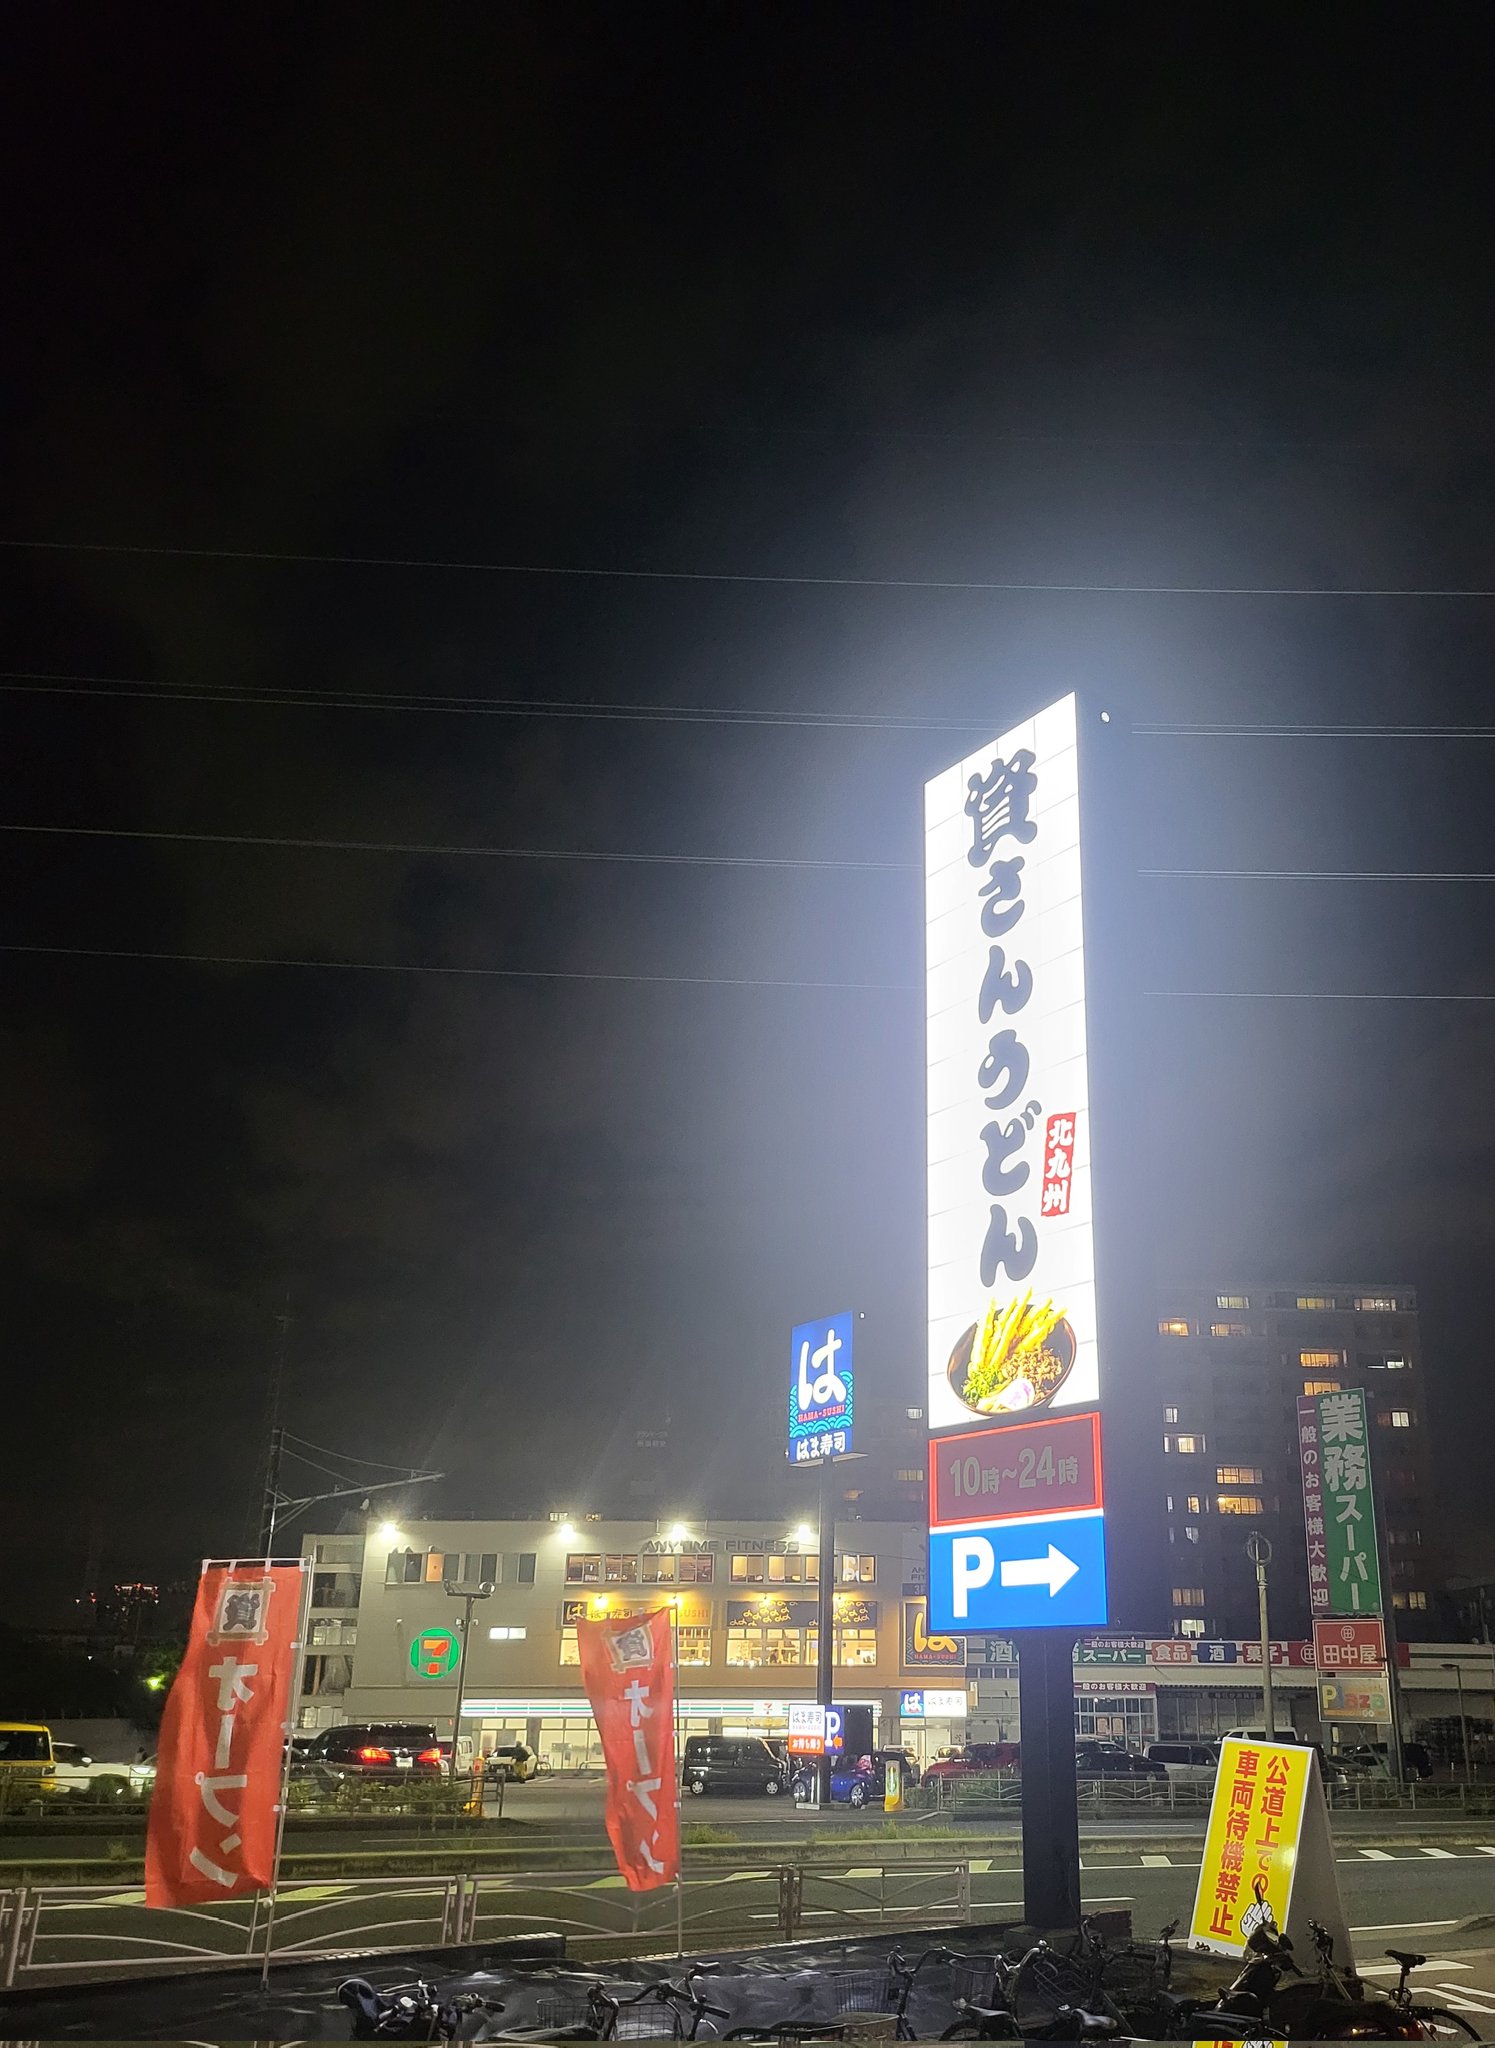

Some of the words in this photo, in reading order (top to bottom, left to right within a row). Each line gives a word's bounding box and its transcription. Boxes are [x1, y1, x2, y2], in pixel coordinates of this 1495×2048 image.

[963, 748, 1042, 1289] 資さんうどん
[1043, 1118, 1074, 1213] 北九州
[798, 1329, 847, 1411] は
[796, 1431, 846, 1461] はま寿司
[1299, 1408, 1329, 1608] 一般のお客様大歓迎
[1319, 1394, 1368, 1610] 業務スーパー
[952, 1536, 995, 1618] P
[1155, 1643, 1188, 1661] 食品
[1209, 1645, 1225, 1661] 酒
[1323, 1644, 1378, 1665] 田中屋
[1209, 1749, 1260, 1936] 車両待機禁止
